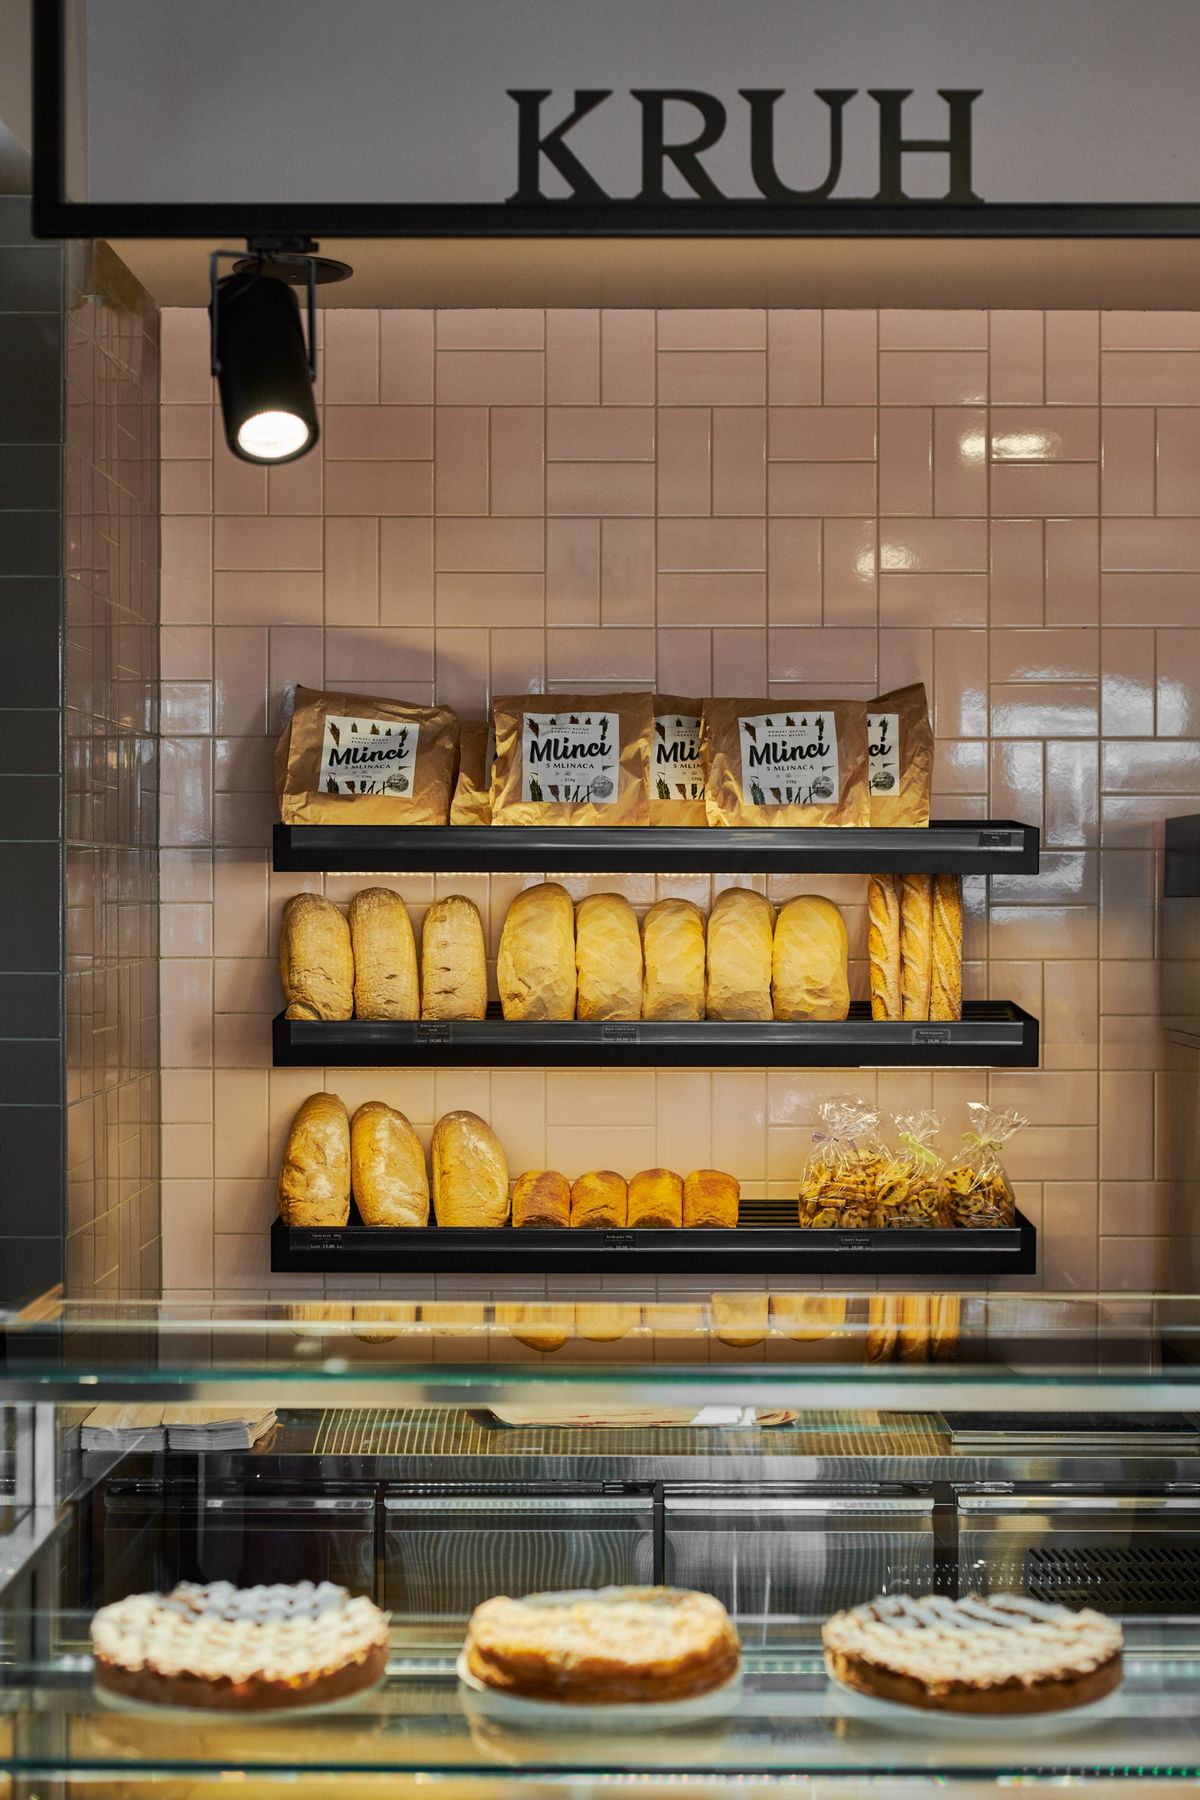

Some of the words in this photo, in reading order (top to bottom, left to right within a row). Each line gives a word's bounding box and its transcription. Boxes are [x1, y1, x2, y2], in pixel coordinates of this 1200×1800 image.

[505, 88, 985, 203] KRUH
[328, 742, 410, 767] Mlinci
[529, 735, 613, 764] Mlinci
[656, 739, 700, 764] Mli
[748, 735, 831, 768] Mlinci
